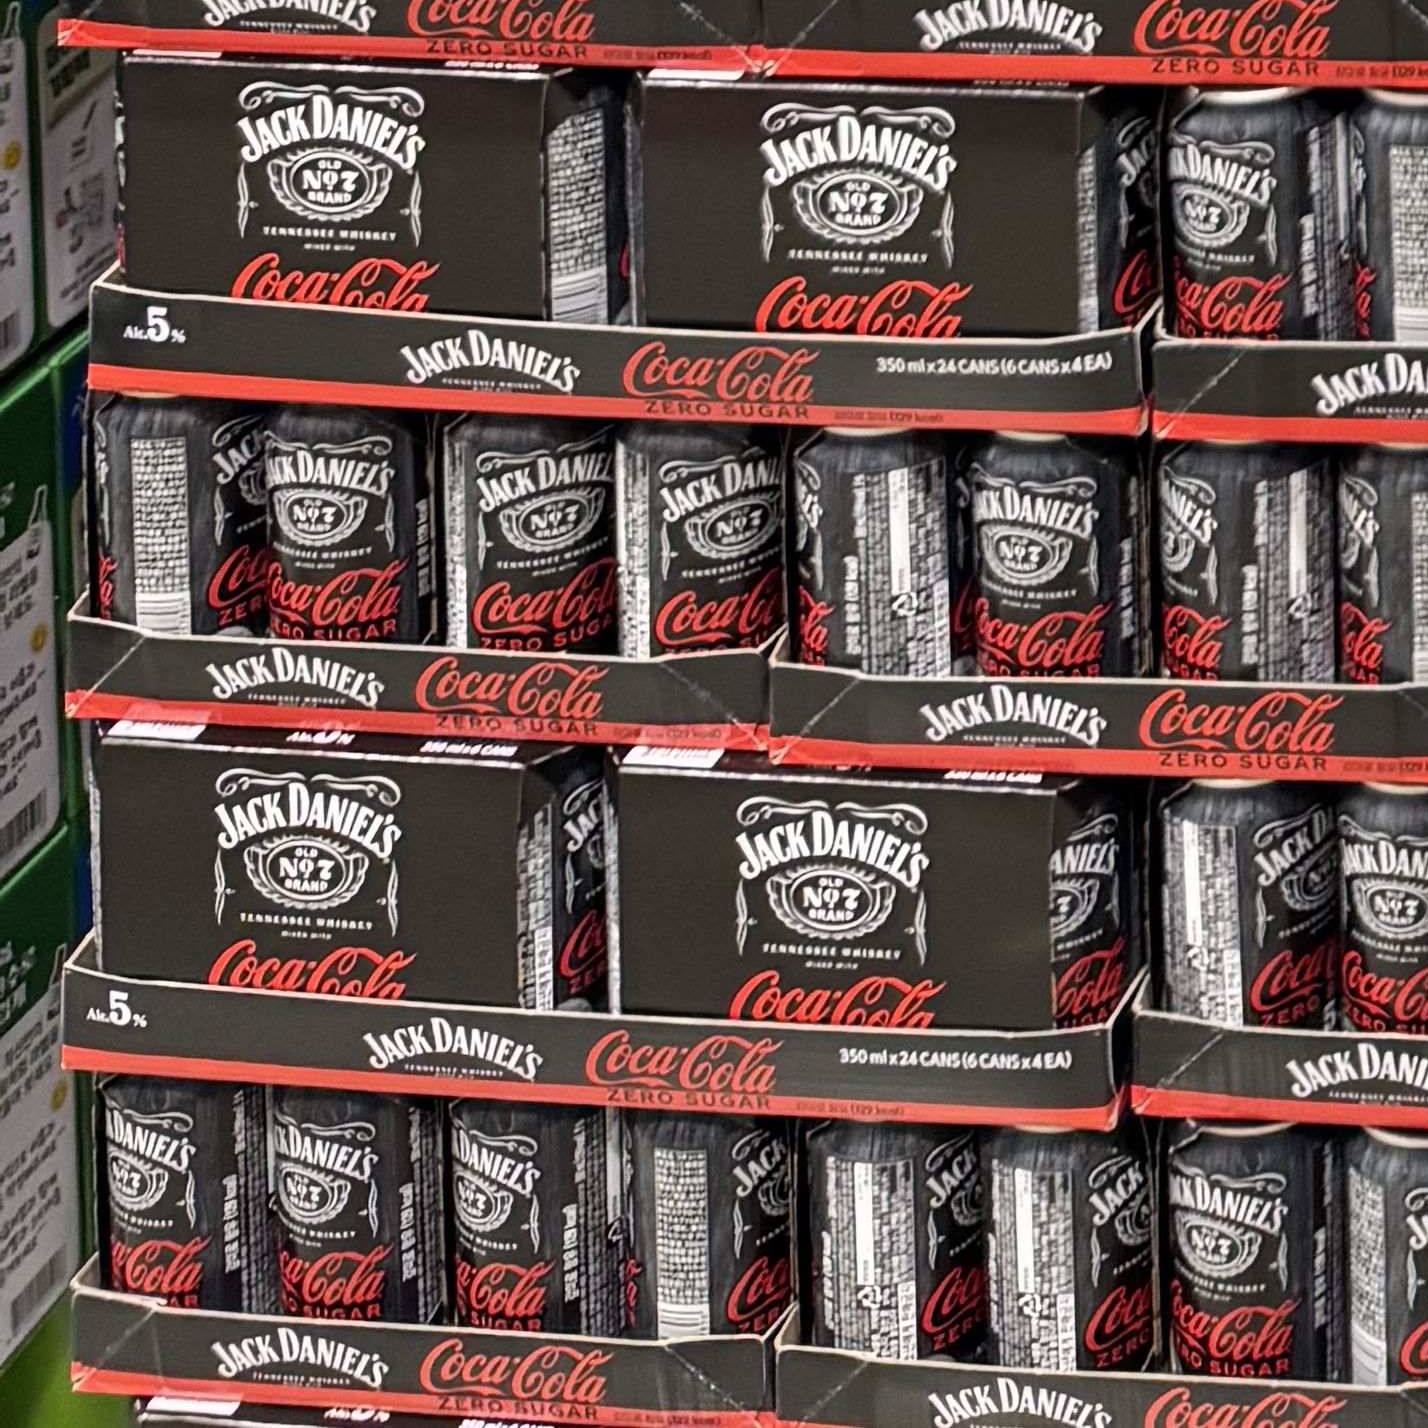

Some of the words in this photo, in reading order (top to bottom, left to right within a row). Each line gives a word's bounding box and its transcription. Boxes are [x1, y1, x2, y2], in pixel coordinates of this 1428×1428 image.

[426, 40, 494, 57] ZERO
[503, 41, 588, 59] SUGAR
[1311, 367, 1384, 418] JACK
[214, 794, 288, 851] JACK
[288, 781, 402, 861] DANIEL'S
[1291, 1053, 1362, 1101] JACK
[209, 1338, 281, 1379] JACK
[278, 1326, 390, 1388] DANIEL'S
[418, 1337, 612, 1404] Coca-Cola
[437, 1395, 505, 1413] ZERO
[515, 1400, 599, 1423] SUGAR
